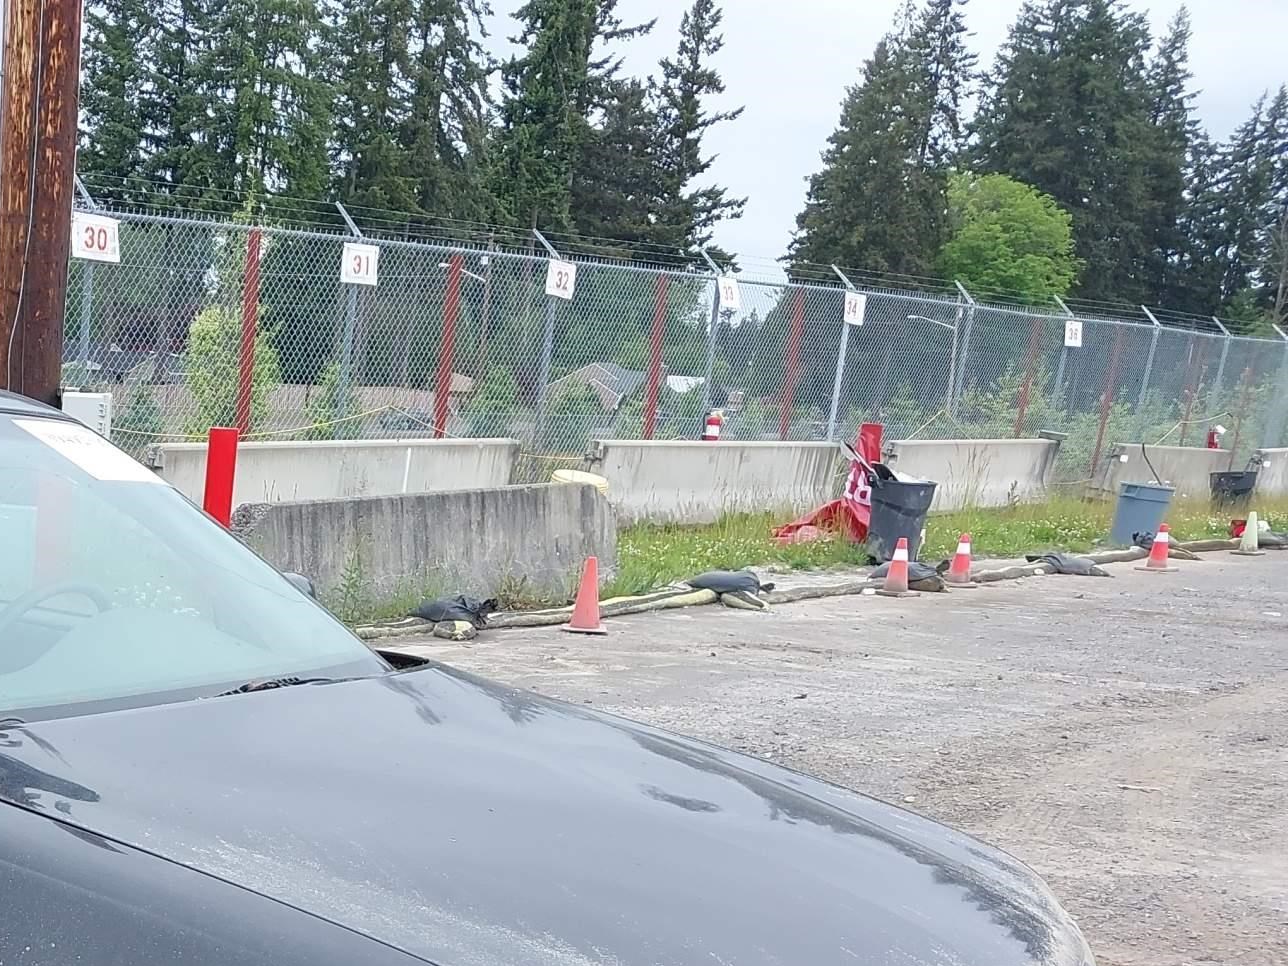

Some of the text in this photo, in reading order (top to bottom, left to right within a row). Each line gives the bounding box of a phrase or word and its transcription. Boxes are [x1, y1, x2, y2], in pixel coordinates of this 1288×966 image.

[84, 226, 108, 251] 30
[353, 254, 370, 276] 31
[555, 270, 569, 290] 32
